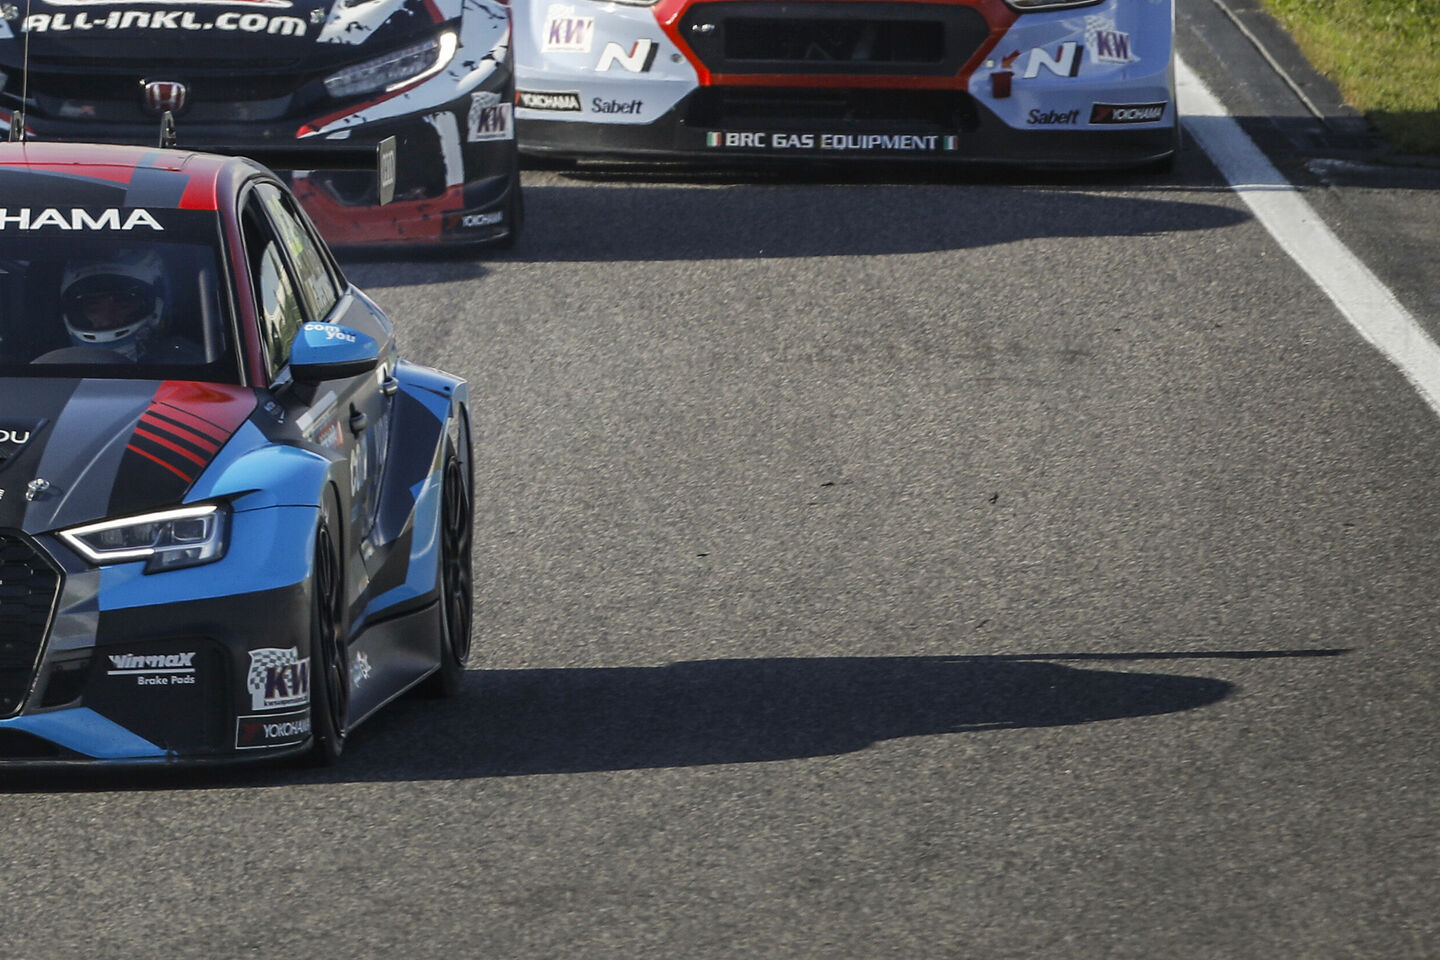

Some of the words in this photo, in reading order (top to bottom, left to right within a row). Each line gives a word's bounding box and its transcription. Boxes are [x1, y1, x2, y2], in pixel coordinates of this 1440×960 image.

[547, 18, 593, 45] KW
[1095, 30, 1130, 60] KW
[519, 93, 581, 110] YOKOHAMA
[591, 97, 644, 115] Sabelt
[1026, 108, 1080, 126] Sabelt
[1111, 107, 1163, 122] YOKOHAMA
[725, 132, 766, 148] BRC
[771, 133, 815, 149] GAS
[819, 134, 939, 151] EQUIPMENT
[303, 324, 340, 333] com
[325, 331, 356, 343] you
[137, 675, 169, 686] Brake
[170, 675, 196, 685] Pads
